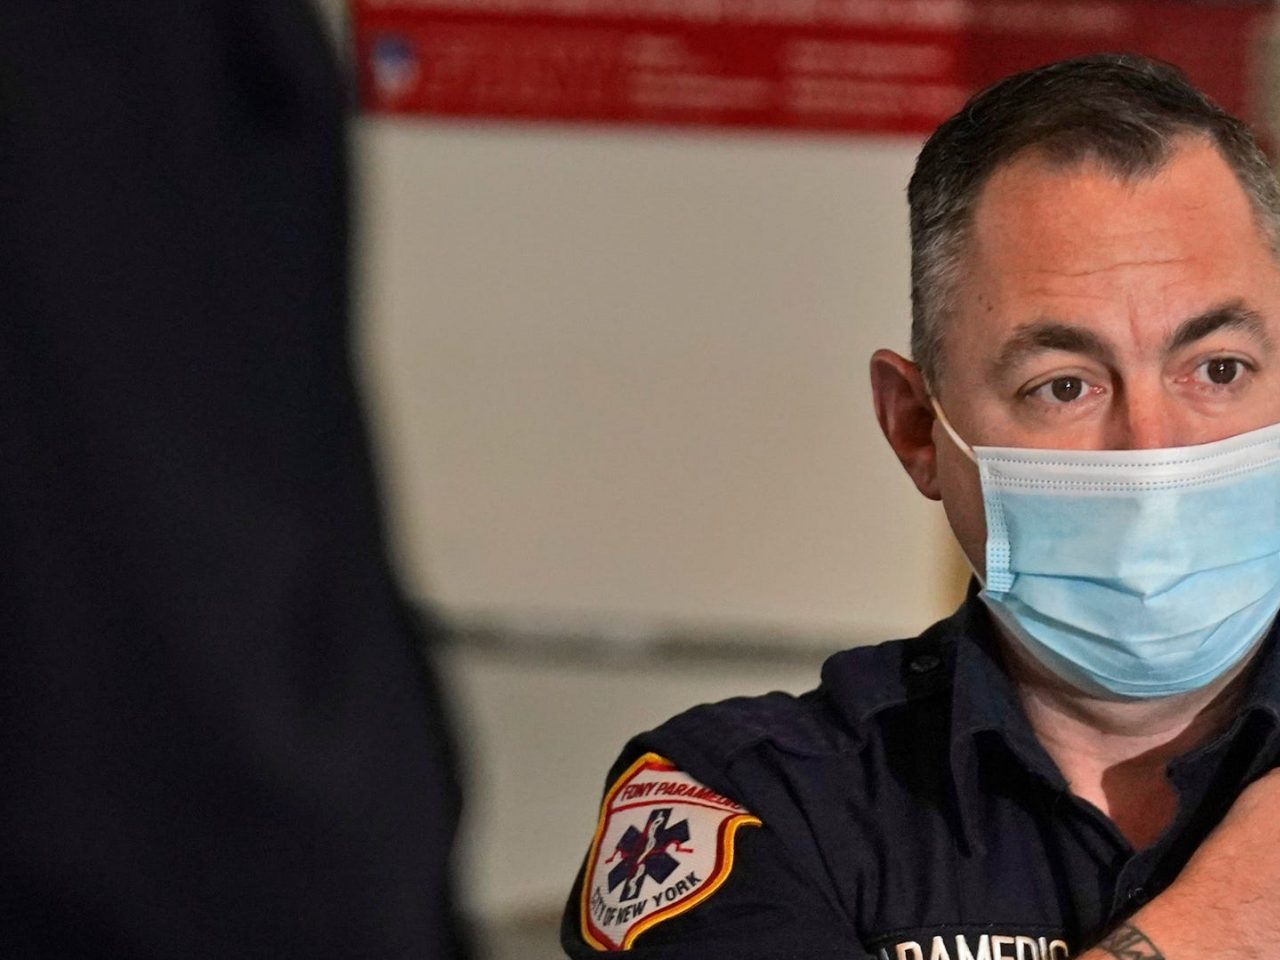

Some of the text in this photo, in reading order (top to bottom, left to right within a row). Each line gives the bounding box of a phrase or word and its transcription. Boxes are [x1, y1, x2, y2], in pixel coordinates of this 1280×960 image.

[621, 782, 741, 810] FDNY PARAM
[615, 899, 648, 925] NEW
[652, 871, 702, 907] YORK
